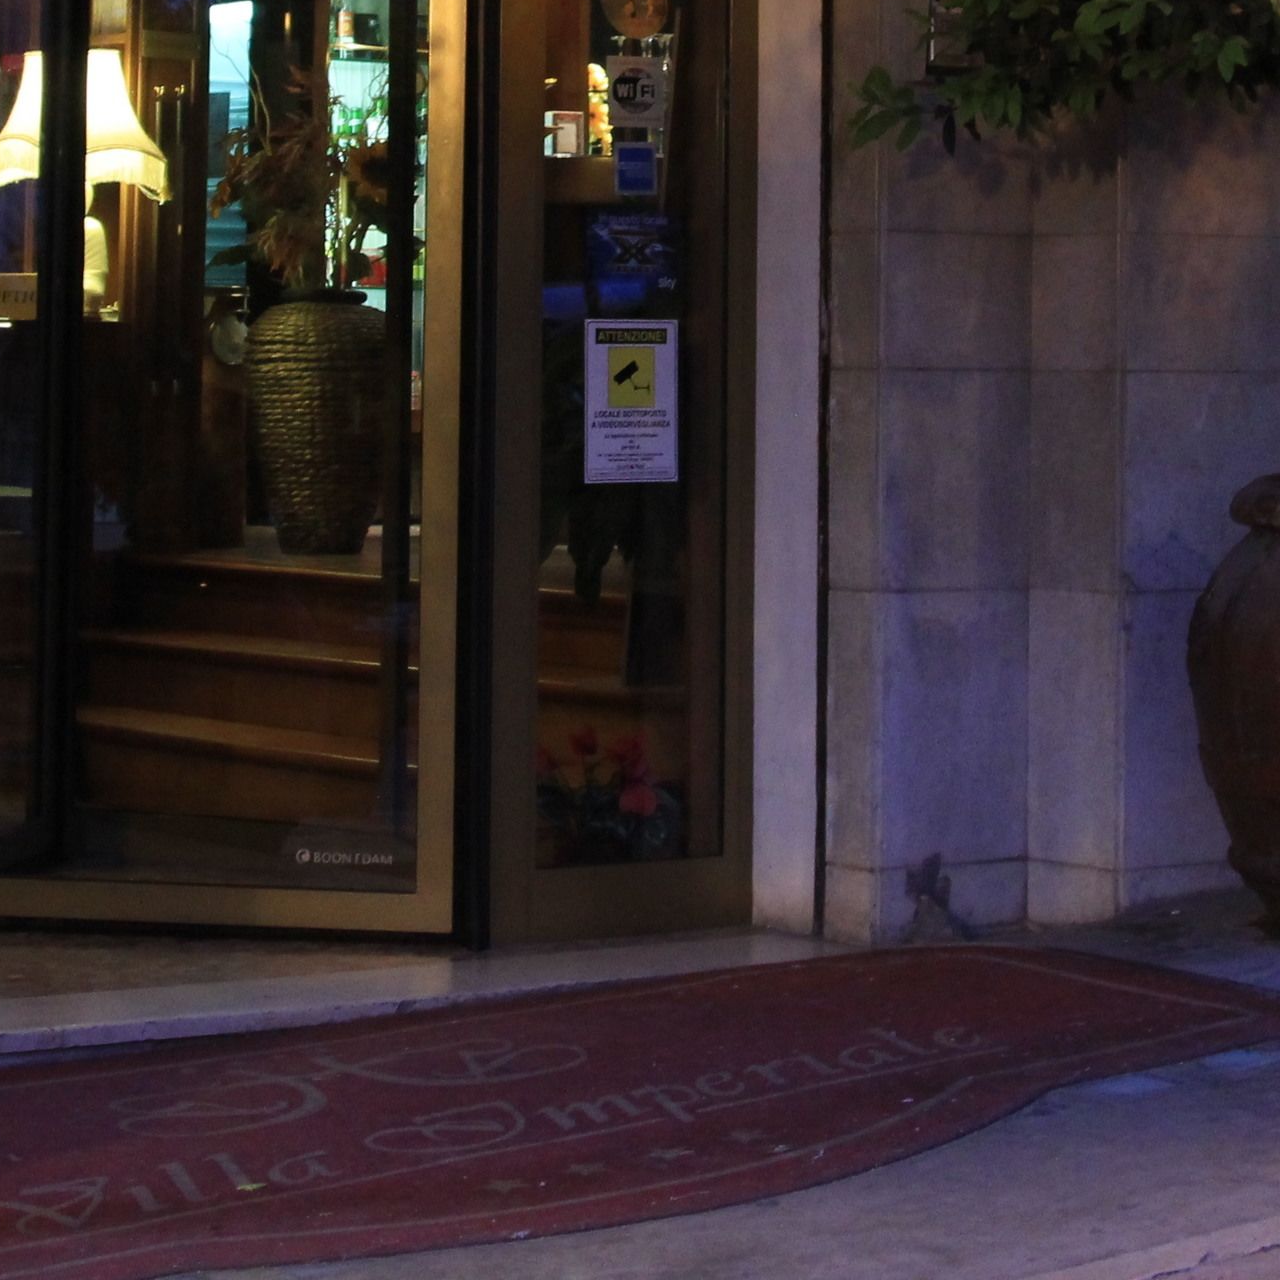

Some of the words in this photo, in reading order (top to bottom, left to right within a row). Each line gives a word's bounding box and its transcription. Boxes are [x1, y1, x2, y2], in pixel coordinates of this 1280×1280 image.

[658, 276, 677, 290] sky
[594, 410, 620, 418] LOCALE
[313, 851, 352, 864] BOON
